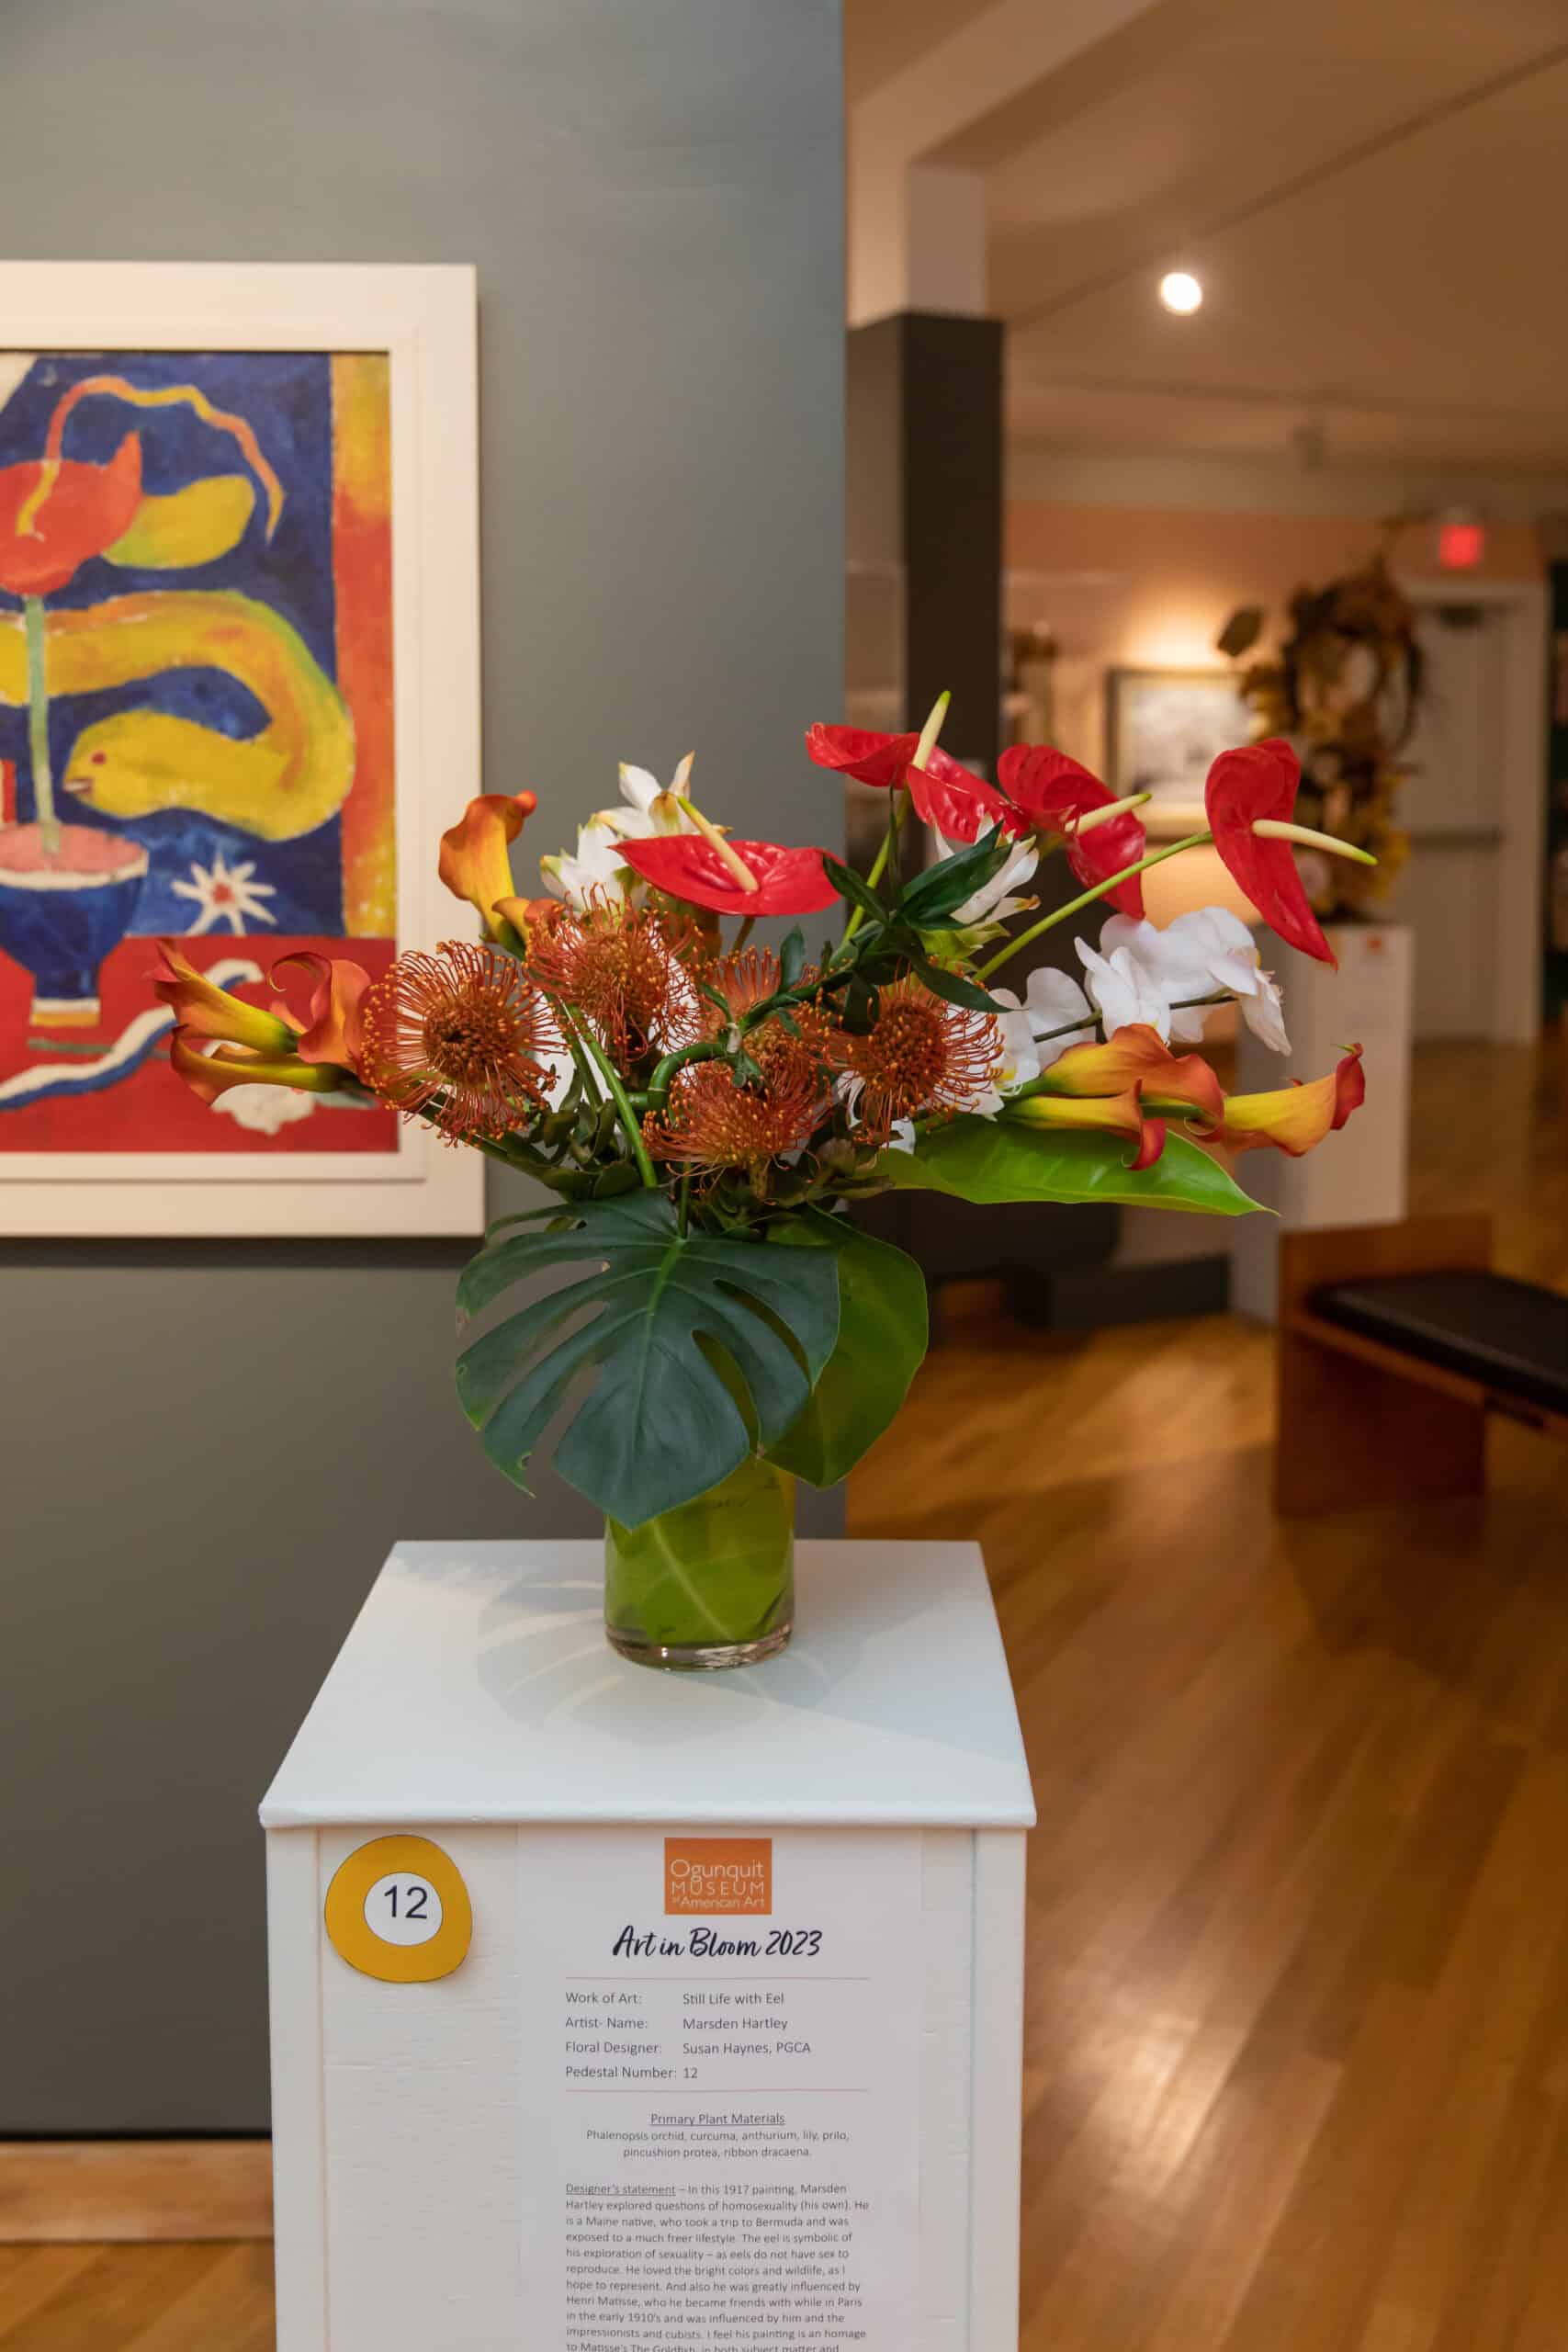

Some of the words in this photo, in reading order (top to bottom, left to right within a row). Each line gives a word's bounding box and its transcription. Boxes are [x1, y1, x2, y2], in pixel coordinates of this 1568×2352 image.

[671, 1859, 764, 1882] Ogunquit
[671, 1881, 764, 1896] MUSEUM
[384, 1884, 428, 1919] 12
[680, 1896, 739, 1908] American
[744, 1896, 764, 1908] Art
[612, 1925, 657, 1958] Art
[660, 1938, 685, 1957] in
[689, 1927, 761, 1957] Bloom
[765, 1929, 823, 1957] 2023
[566, 1992, 599, 2003] Work
[603, 1992, 615, 2003] of
[618, 1992, 642, 2003] Art:
[683, 1994, 707, 2005] Still
[709, 1994, 730, 2005] Life
[735, 1993, 761, 2004] with
[764, 1993, 784, 2004] Eel
[566, 2017, 604, 2028] Artist-
[607, 2017, 647, 2028] Name:
[683, 2018, 738, 2029] Marsden
[743, 2018, 787, 2030] Hartley
[566, 2042, 602, 2053] Floral
[604, 2042, 661, 2055] Designer:
[683, 2043, 719, 2054] Susan
[724, 2041, 773, 2054] Haynes,
[777, 2040, 810, 2051] PGCA
[566, 2066, 619, 2077] Pedestal
[622, 2066, 676, 2077] Number:
[683, 2068, 697, 2079] 12
[651, 2113, 695, 2126] Primary
[699, 2113, 728, 2123] Plant
[731, 2112, 784, 2122] Materials
[587, 2130, 649, 2143] Phalenopsis
[691, 2133, 739, 2143] curcuma,
[623, 2146, 681, 2159] pincushion
[682, 2146, 721, 2159] protea,
[725, 2146, 758, 2156] ribbon
[566, 2185, 619, 2198] Designer's
[623, 2184, 675, 2194] statement
[688, 2183, 698, 2193] In
[701, 2183, 720, 2193] this
[725, 2183, 750, 2193] 1917
[801, 2183, 847, 2193] Marsden
[566, 2199, 604, 2211] Hartley
[606, 2199, 652, 2212] explored
[655, 2199, 705, 2212] questions
[708, 2199, 718, 2210] of
[722, 2199, 796, 2212] homosexuality
[801, 2199, 819, 2211] (his
[854, 2199, 869, 2209] He
[566, 2214, 573, 2224] is
[586, 2215, 619, 2225] Maine
[622, 2216, 659, 2229] native,
[660, 2216, 682, 2226] who
[685, 2216, 709, 2226] took
[720, 2216, 739, 2229] trip
[742, 2216, 753, 2226] to
[756, 2216, 805, 2226] Bermuda
[807, 2215, 826, 2225] and
[566, 2231, 610, 2244] exposed
[613, 2232, 624, 2242] to
[635, 2232, 664, 2242] much
[667, 2232, 694, 2242] freer
[742, 2232, 761, 2242] The
[764, 2232, 781, 2242] eel
[783, 2232, 790, 2242] is
[793, 2232, 840, 2245] symbolic
[841, 2232, 852, 2242] of
[566, 2246, 581, 2256] his
[583, 2247, 642, 2260] exploration
[645, 2248, 656, 2258] of
[659, 2248, 704, 2261] sexuality
[729, 2248, 750, 2258] eels
[752, 2248, 768, 2258] do
[770, 2248, 787, 2258] not
[791, 2248, 816, 2258] have
[838, 2247, 849, 2257] to
[626, 2264, 640, 2274] He
[643, 2264, 671, 2274] loved
[674, 2265, 693, 2275] the
[694, 2265, 727, 2278] bright
[728, 2265, 761, 2275] colors
[762, 2265, 782, 2275] and
[785, 2264, 827, 2277] wildlife,
[567, 2278, 593, 2291] hope
[595, 2278, 606, 2289] to
[666, 2280, 686, 2290] And
[690, 2280, 711, 2290] also
[713, 2280, 727, 2290] he
[751, 2280, 788, 2293] greatly
[791, 2280, 845, 2290] influenced
[848, 2280, 860, 2293] by
[567, 2294, 594, 2304] Henri
[598, 2295, 640, 2308] Matisse,
[644, 2296, 667, 2306] who
[669, 2297, 682, 2307] he
[685, 2297, 727, 2307] became
[730, 2297, 765, 2307] friends
[769, 2297, 791, 2307] with
[794, 2296, 822, 2306] while
[826, 2296, 834, 2306] in
[838, 2296, 862, 2306] Paris
[567, 2309, 576, 2319] in
[579, 2310, 597, 2320] the
[599, 2311, 625, 2324] early
[628, 2312, 662, 2322] 1910's
[663, 2312, 683, 2322] and
[711, 2312, 764, 2323] influenced
[767, 2312, 779, 2325] by
[783, 2312, 801, 2323] him
[806, 2312, 824, 2322] and
[828, 2312, 845, 2322] the
[567, 2326, 639, 2339] impressionists
[642, 2327, 663, 2337] and
[713, 2328, 733, 2338] feel
[736, 2328, 750, 2338] his
[752, 2328, 795, 2341] painting
[798, 2328, 807, 2338] is
[824, 2328, 865, 2341] homage
